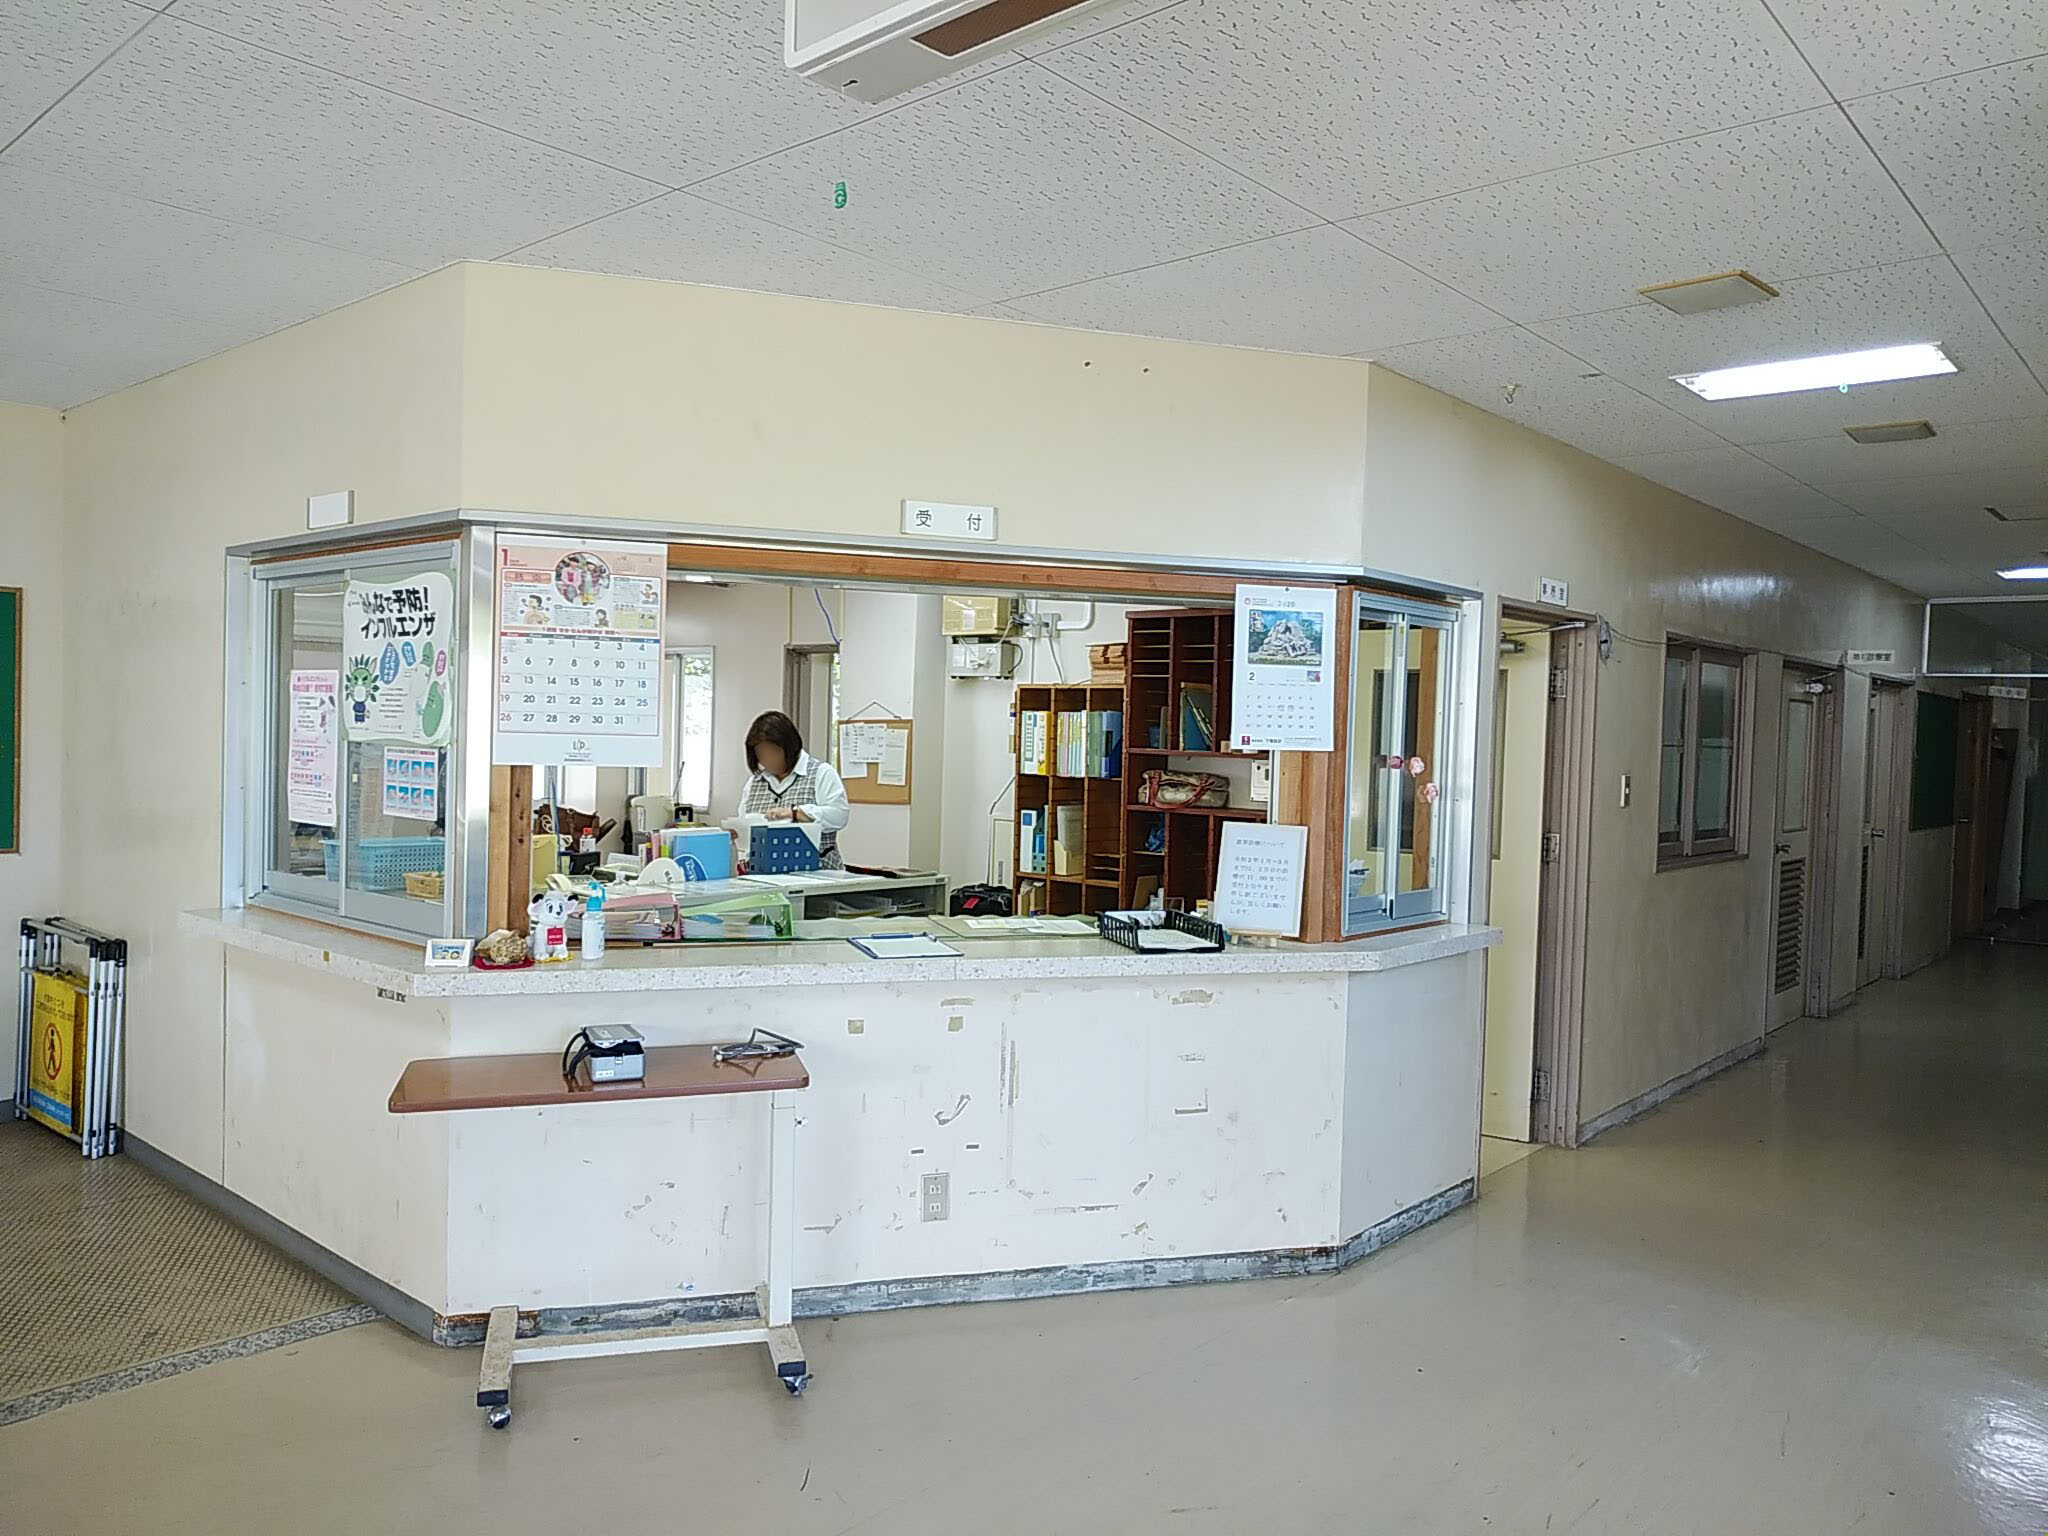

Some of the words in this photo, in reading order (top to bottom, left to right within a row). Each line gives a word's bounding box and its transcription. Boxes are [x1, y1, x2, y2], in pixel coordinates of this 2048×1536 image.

[915, 509, 982, 531] 受付
[501, 548, 509, 566] 1
[361, 612, 437, 639] インフルエンザ
[616, 661, 625, 669] 10
[638, 661, 646, 669] 11
[501, 675, 511, 684] 12
[524, 676, 533, 684] 13
[570, 678, 579, 686] 15
[615, 679, 624, 687] 17
[638, 680, 646, 688] 18
[1249, 672, 1255, 681] 2
[500, 694, 510, 702] 19
[523, 695, 535, 703] 20
[569, 696, 581, 704] 22
[592, 697, 603, 705] 23
[500, 713, 512, 721] 26
[546, 714, 557, 722] 28
[569, 715, 580, 723] 29
[592, 716, 603, 724] 30
[614, 716, 623, 724] 31
